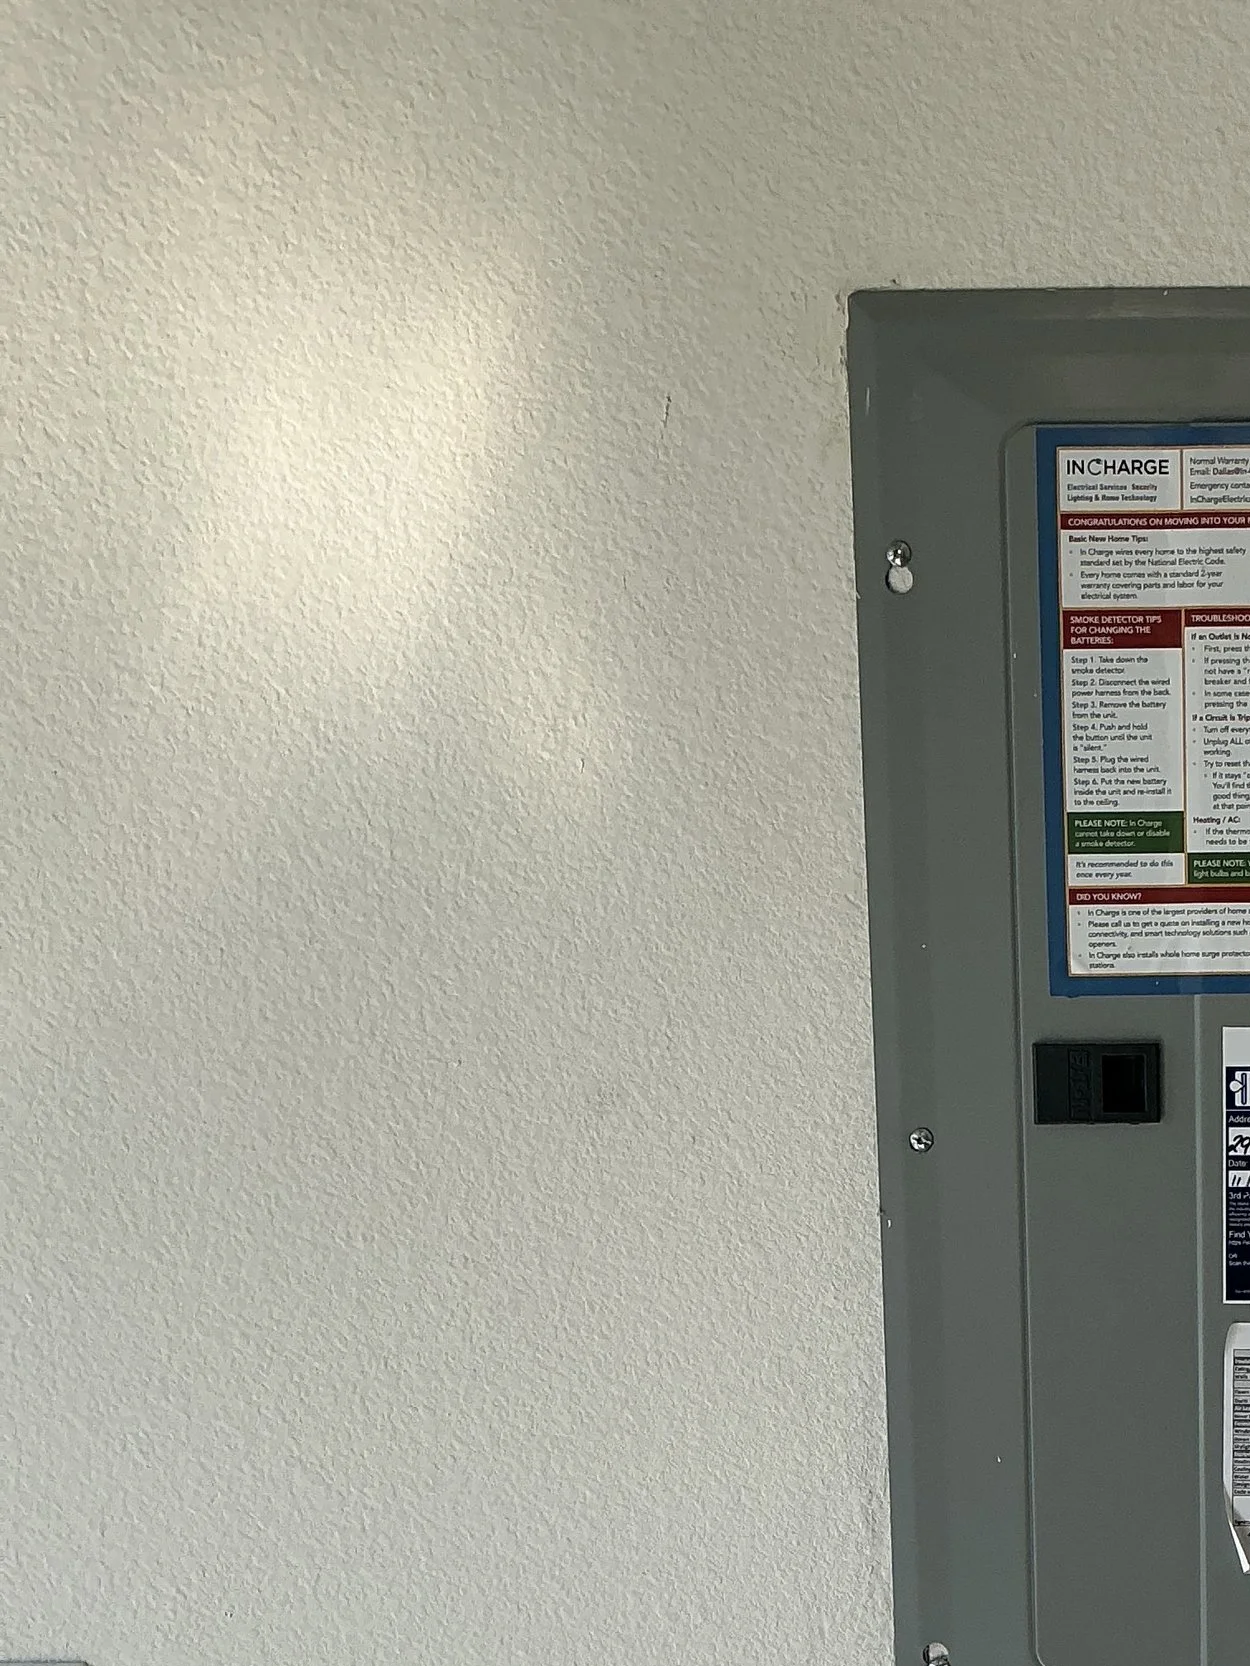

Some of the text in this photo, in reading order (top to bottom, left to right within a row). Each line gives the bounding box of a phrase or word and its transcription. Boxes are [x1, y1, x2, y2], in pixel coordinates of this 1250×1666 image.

[1190, 456, 1216, 465] Normal
[1216, 456, 1249, 466] Warranty
[1066, 458, 1170, 475] INCHARGE
[1067, 483, 1098, 491] Electrical
[1131, 482, 1158, 491] Security
[1190, 481, 1229, 491] Emergency
[1067, 493, 1157, 502] Lighting & Home Technology
[1068, 517, 1147, 526] CONGRATULATIONS
[1148, 517, 1162, 526] ON
[1164, 516, 1199, 525] MOVING
[1200, 516, 1220, 524] INTO
[1222, 516, 1245, 524] YOUR
[1068, 534, 1148, 544] Basic New Home Tips:
[1087, 547, 1113, 557] Charge
[1134, 549, 1154, 557] every
[1154, 547, 1175, 555] home
[1185, 546, 1197, 554] the
[1198, 546, 1224, 556] highest
[1225, 546, 1246, 556] safety
[1080, 558, 1110, 566] standard
[1123, 558, 1133, 568] by
[1134, 558, 1146, 566] the
[1147, 558, 1177, 566] National
[1178, 557, 1203, 565] Electric
[1080, 570, 1100, 580] Every
[1100, 570, 1121, 578] home
[1146, 570, 1162, 578] with
[1168, 569, 1199, 578] standard
[1070, 615, 1162, 623] SMOKE DETECTOR TIPS
[1070, 625, 1151, 634] FOR CHANGING THE
[1070, 636, 1114, 644] BATTERIES:
[1191, 632, 1196, 640] If
[1208, 632, 1231, 640] Outlet
[1233, 632, 1240, 640] is
[1071, 655, 1088, 665] Step
[1098, 655, 1114, 663] Take
[1115, 655, 1135, 663] down
[1136, 655, 1148, 663] the
[1204, 677, 1231, 685] breaker
[1233, 676, 1247, 684] and
[1192, 713, 1197, 721] If
[1204, 713, 1228, 721] Circuit
[1229, 713, 1235, 721] is
[1075, 819, 1102, 827] PLEASE
[1103, 819, 1127, 827] NOTE:
[1137, 819, 1162, 828] Charge
[1193, 816, 1220, 825] Heating
[1227, 815, 1241, 823] AC:
[1076, 892, 1142, 900] DID YOU KNOW?
[1228, 1191, 1241, 1199] 3rd
[1228, 1230, 1245, 1238] Find
